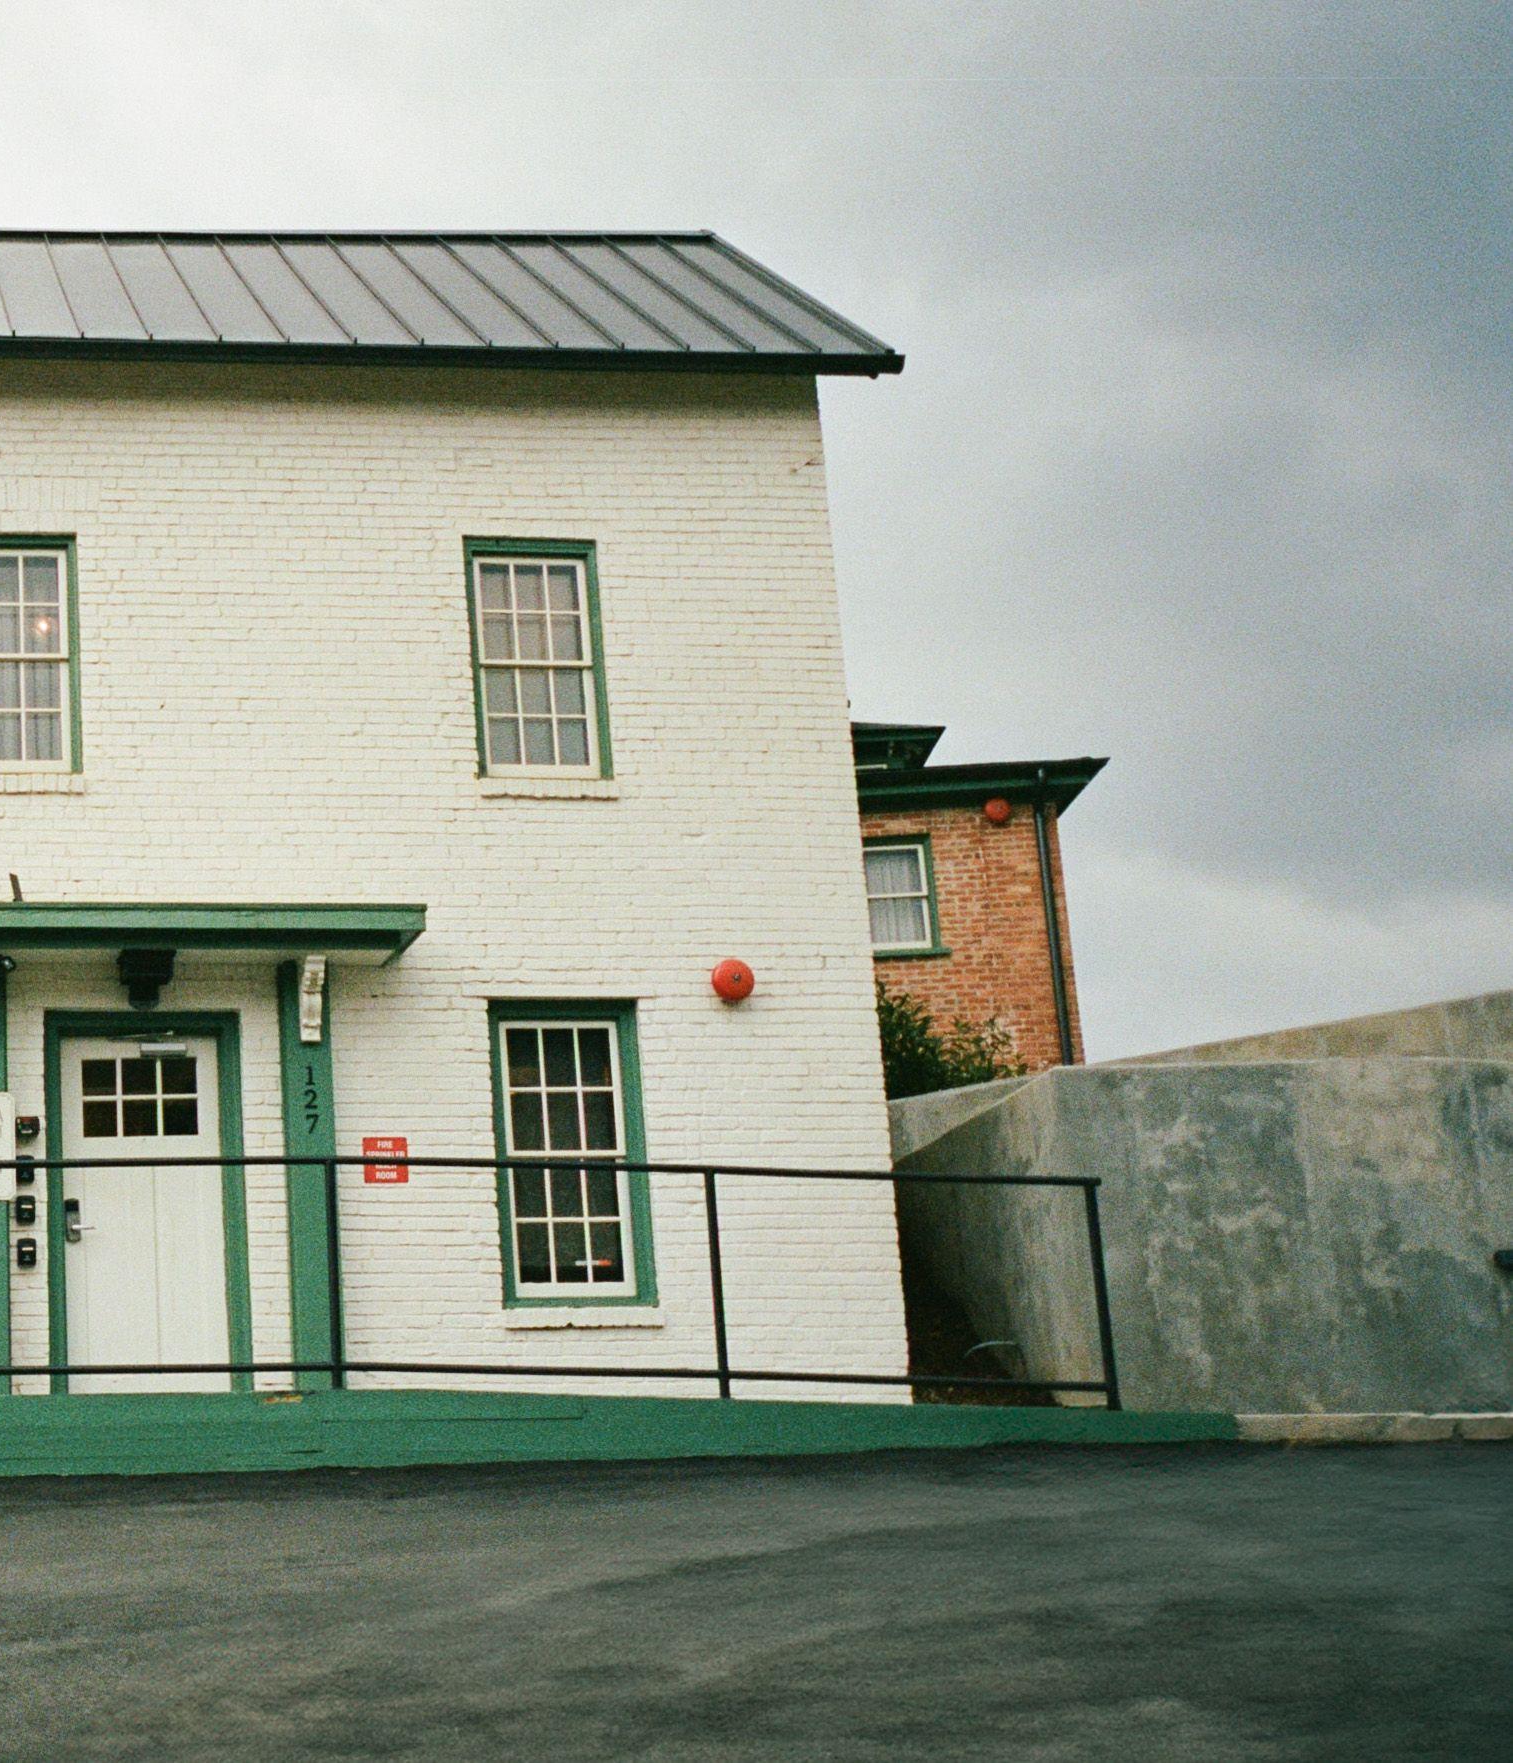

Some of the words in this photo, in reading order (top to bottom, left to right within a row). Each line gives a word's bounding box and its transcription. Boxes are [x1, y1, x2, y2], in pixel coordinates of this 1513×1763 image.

[304, 1065, 319, 1135] 127
[377, 1140, 393, 1149] FIRE
[375, 1171, 397, 1179] ROOM
